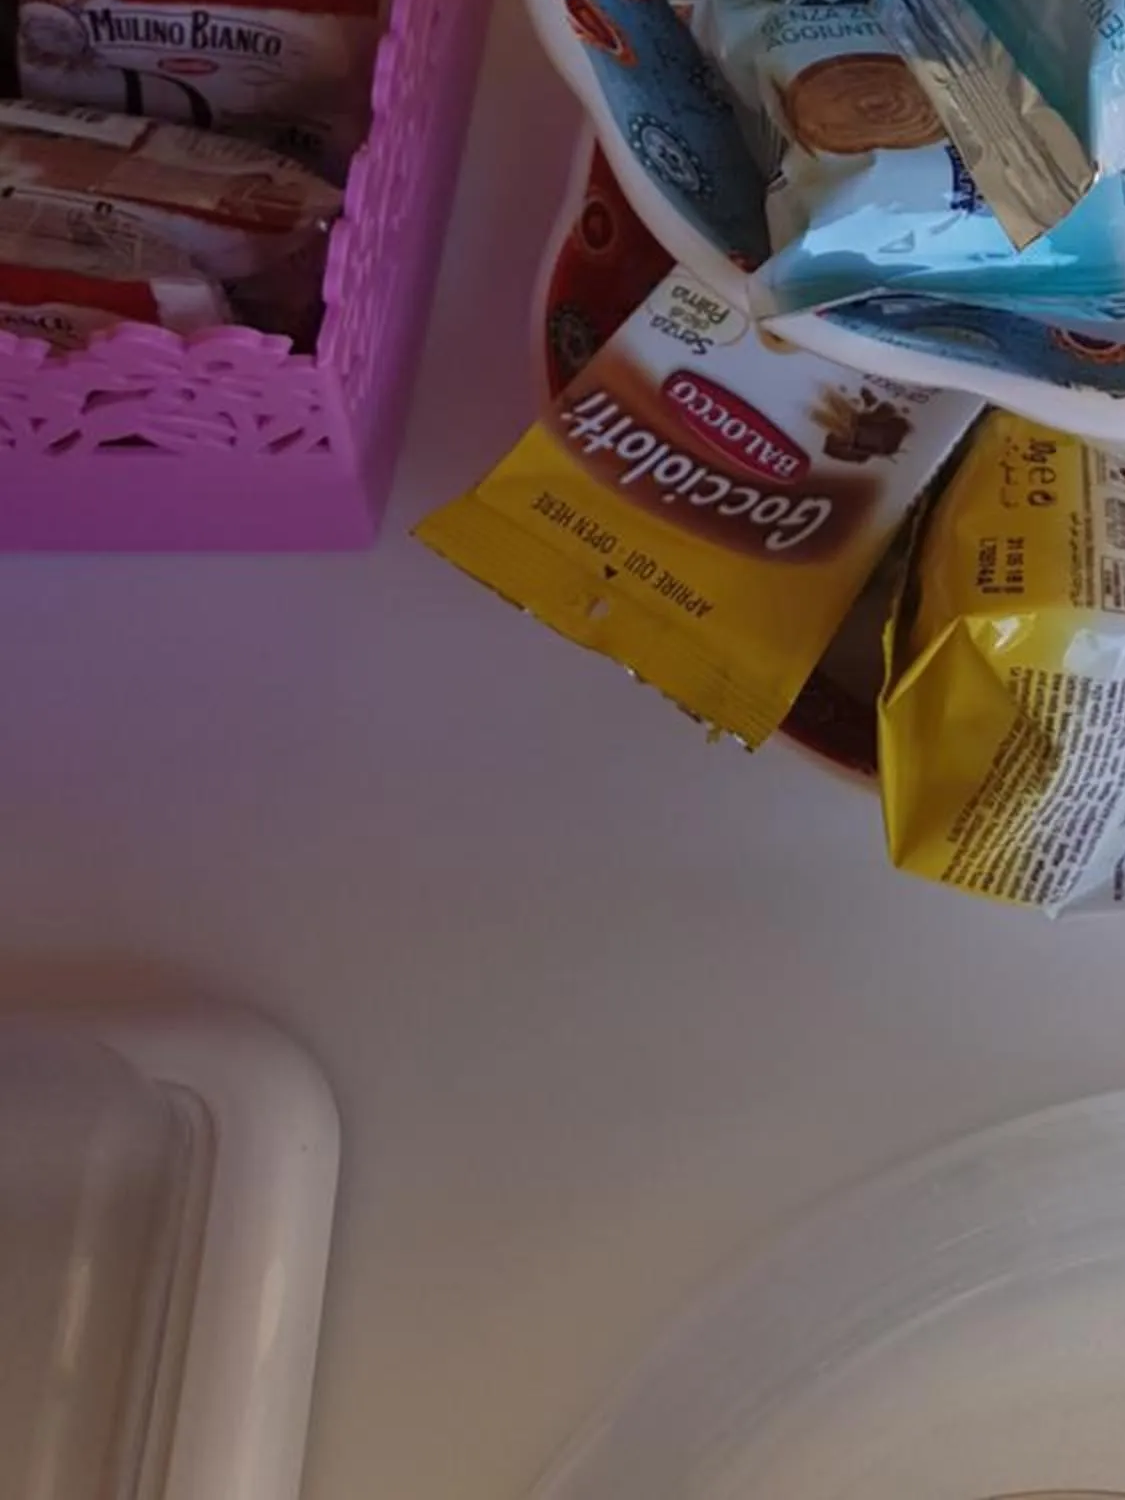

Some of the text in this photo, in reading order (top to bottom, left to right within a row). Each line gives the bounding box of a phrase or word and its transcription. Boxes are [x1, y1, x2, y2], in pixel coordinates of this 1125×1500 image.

[88, 8, 283, 57] MULINO BIANCO
[652, 313, 714, 355] Senza
[560, 391, 832, 551] Gocciolotti
[670, 380, 799, 478] BALOCCO
[530, 491, 714, 619] APRIRE QUI OPEN HERE
